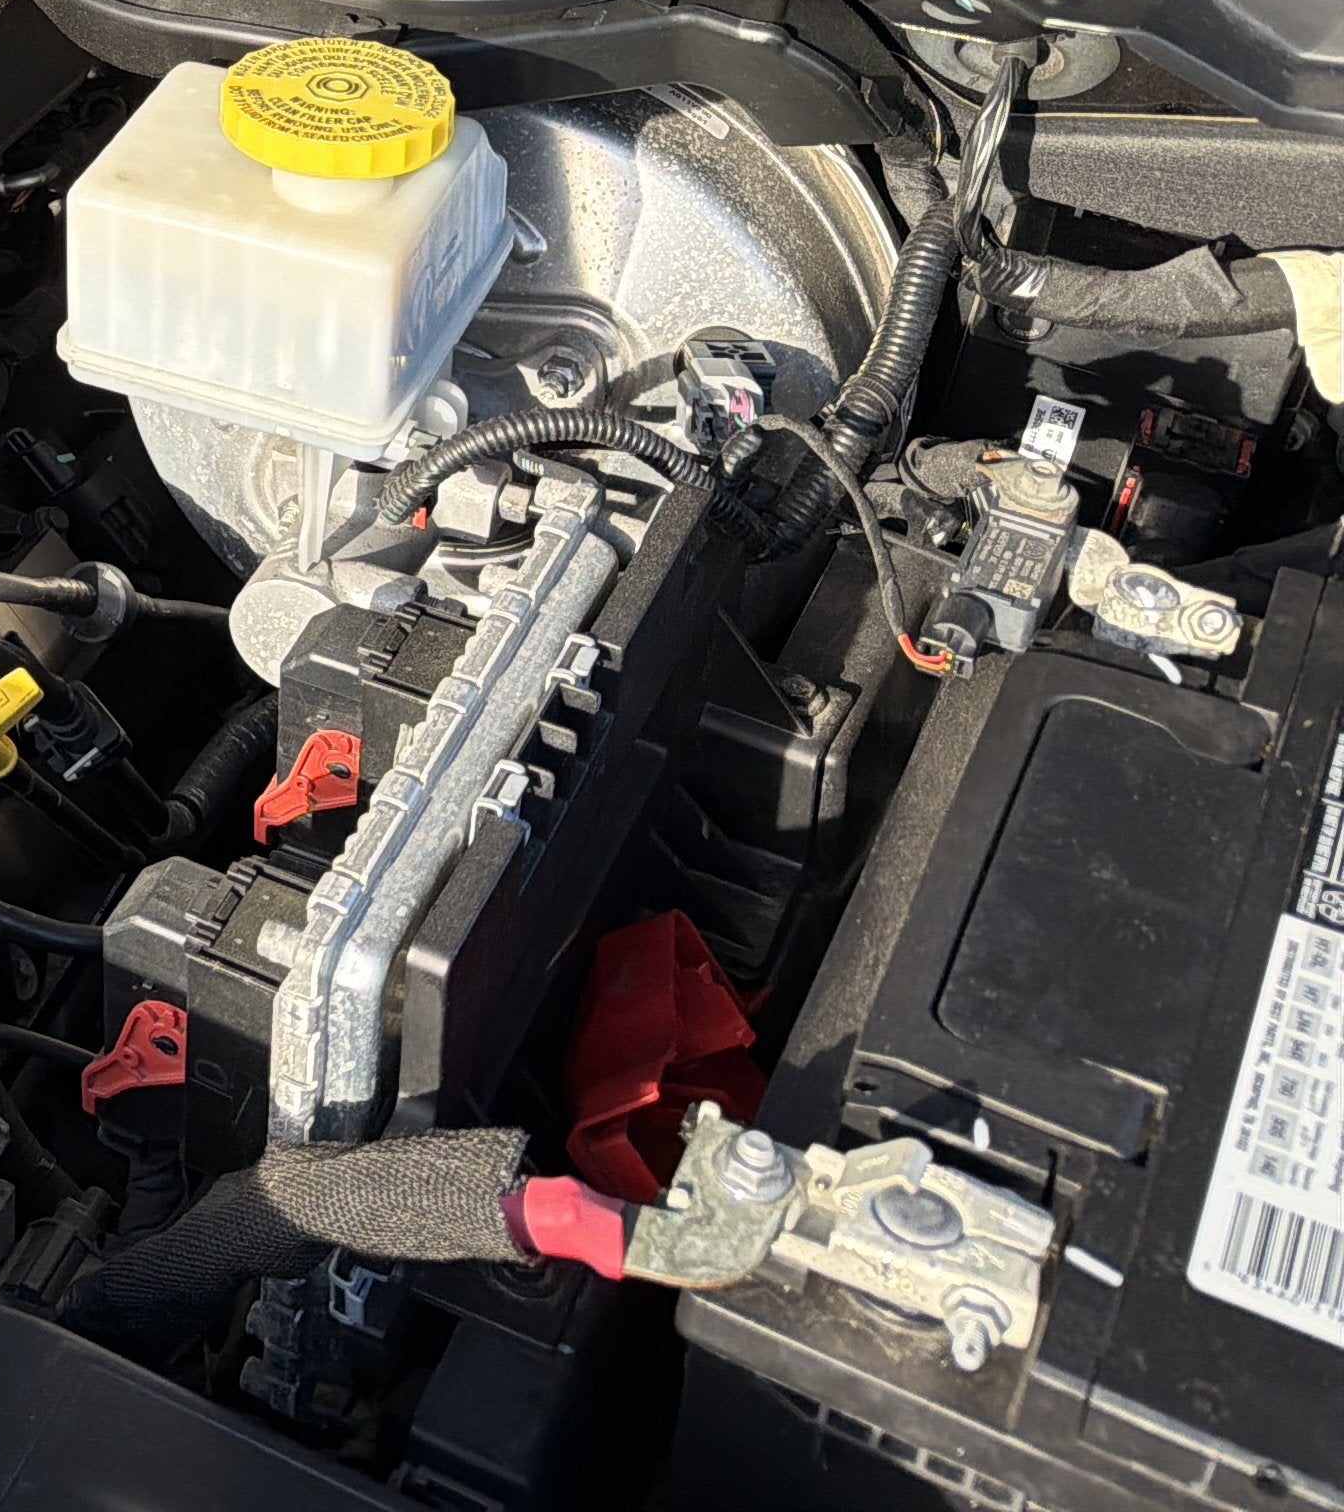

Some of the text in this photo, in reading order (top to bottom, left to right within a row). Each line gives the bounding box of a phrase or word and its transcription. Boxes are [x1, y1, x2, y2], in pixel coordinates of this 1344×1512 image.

[268, 97, 301, 116] CLEAN
[299, 112, 344, 125] FILLER
[258, 117, 291, 133] FROM
[302, 131, 350, 142] SEALED
[340, 126, 369, 134] USE
